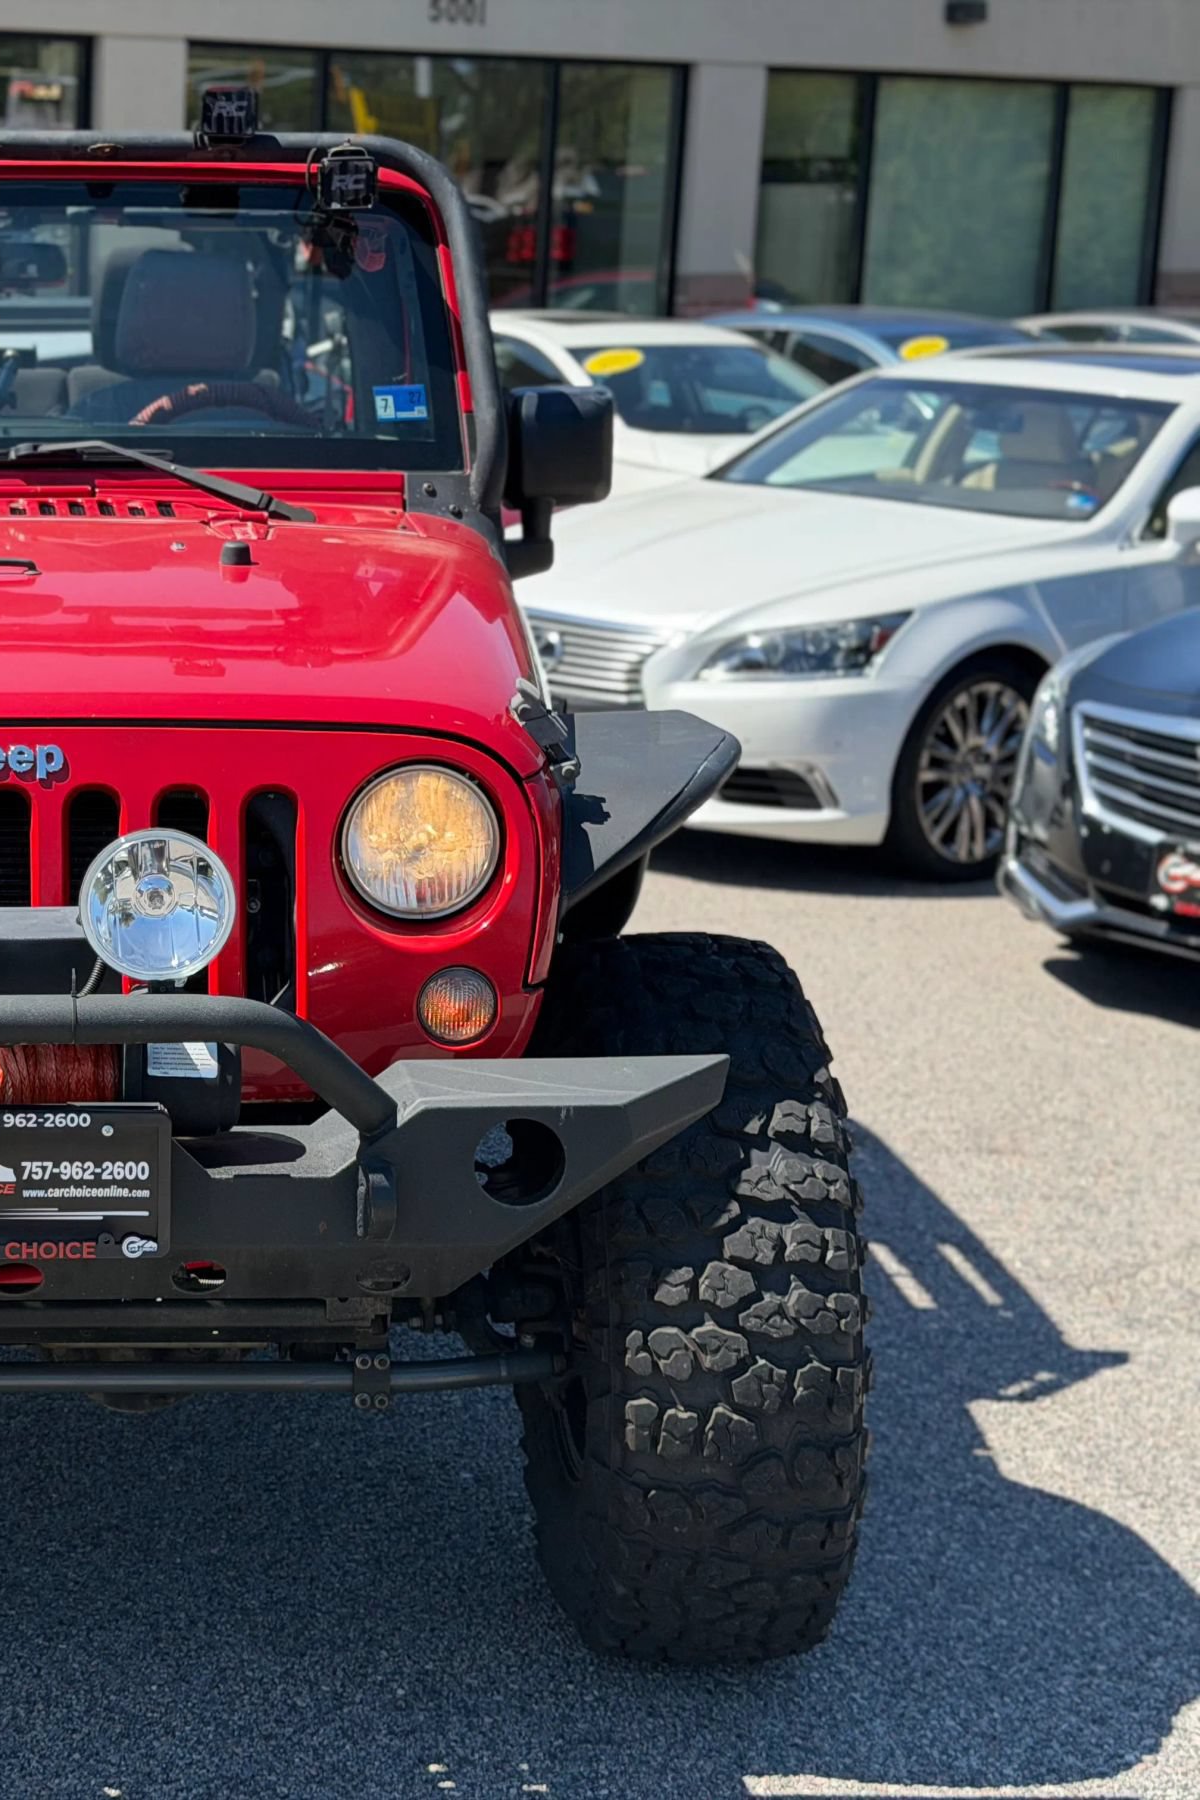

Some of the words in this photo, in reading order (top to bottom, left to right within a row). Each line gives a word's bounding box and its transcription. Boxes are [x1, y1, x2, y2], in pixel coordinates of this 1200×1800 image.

[330, 174, 367, 191] RC
[3, 1113, 91, 1128] 962-2600
[21, 1161, 150, 1181] 757-962-2600
[22, 1184, 151, 1198] www.carchoiceonline.com
[4, 1241, 97, 1260] CHOICE
